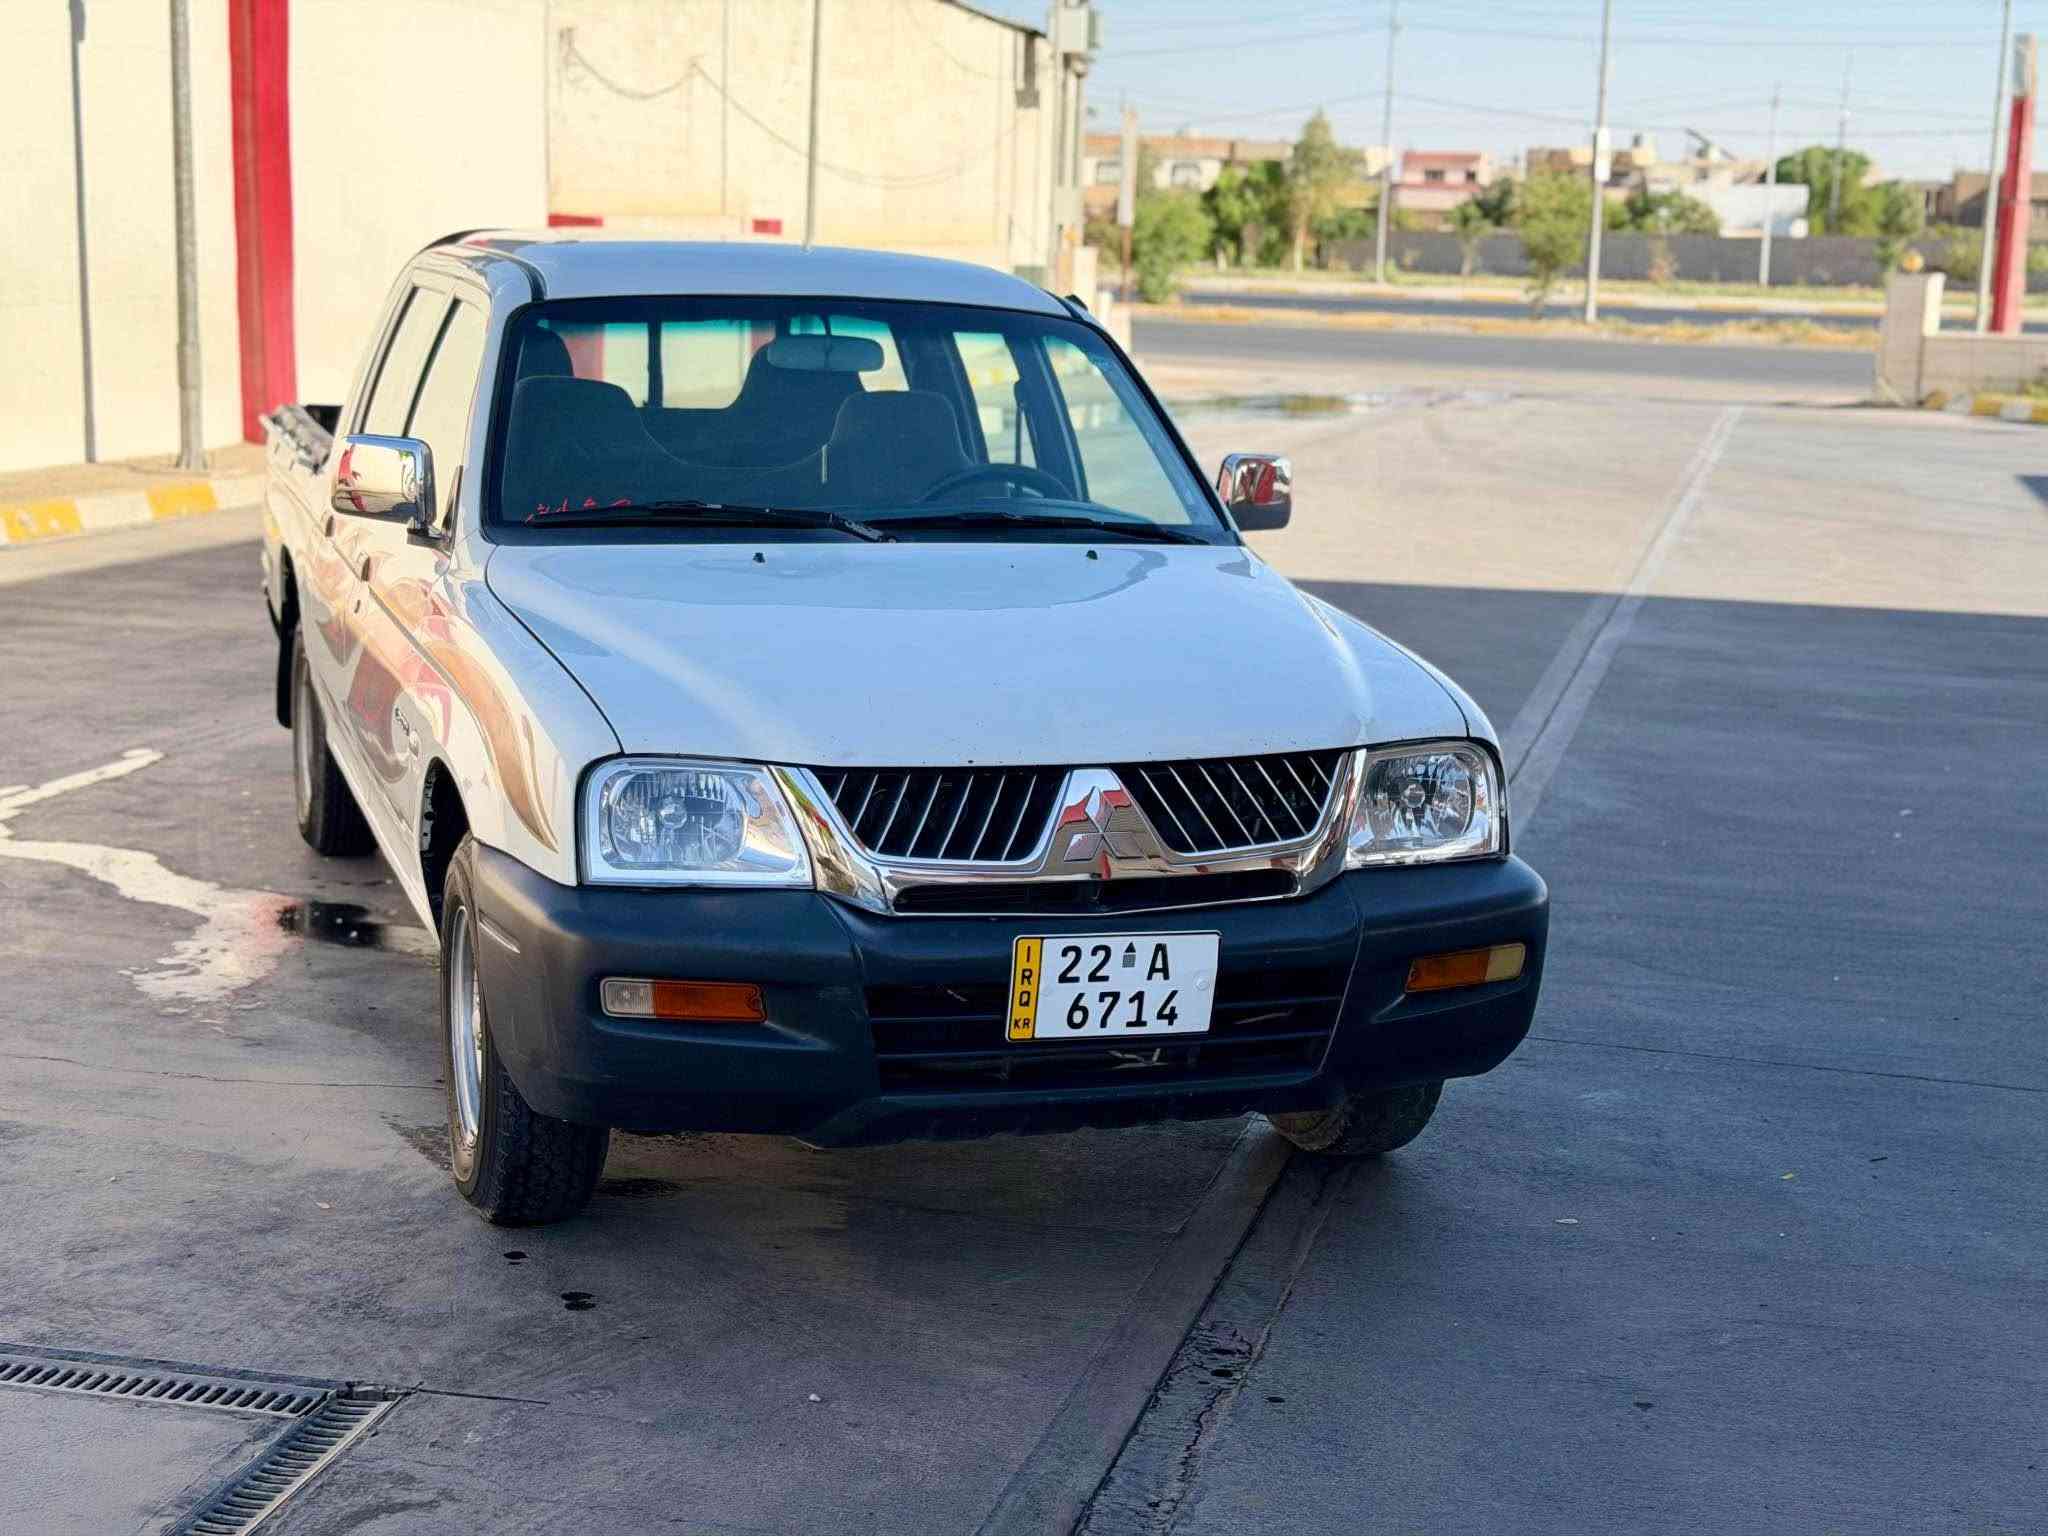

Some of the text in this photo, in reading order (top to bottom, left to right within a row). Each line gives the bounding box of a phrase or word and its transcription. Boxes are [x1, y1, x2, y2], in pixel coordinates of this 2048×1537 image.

[1057, 943, 1170, 984] 22 A
[1013, 1018, 1031, 1030] KR
[1066, 990, 1179, 1030] 6714
